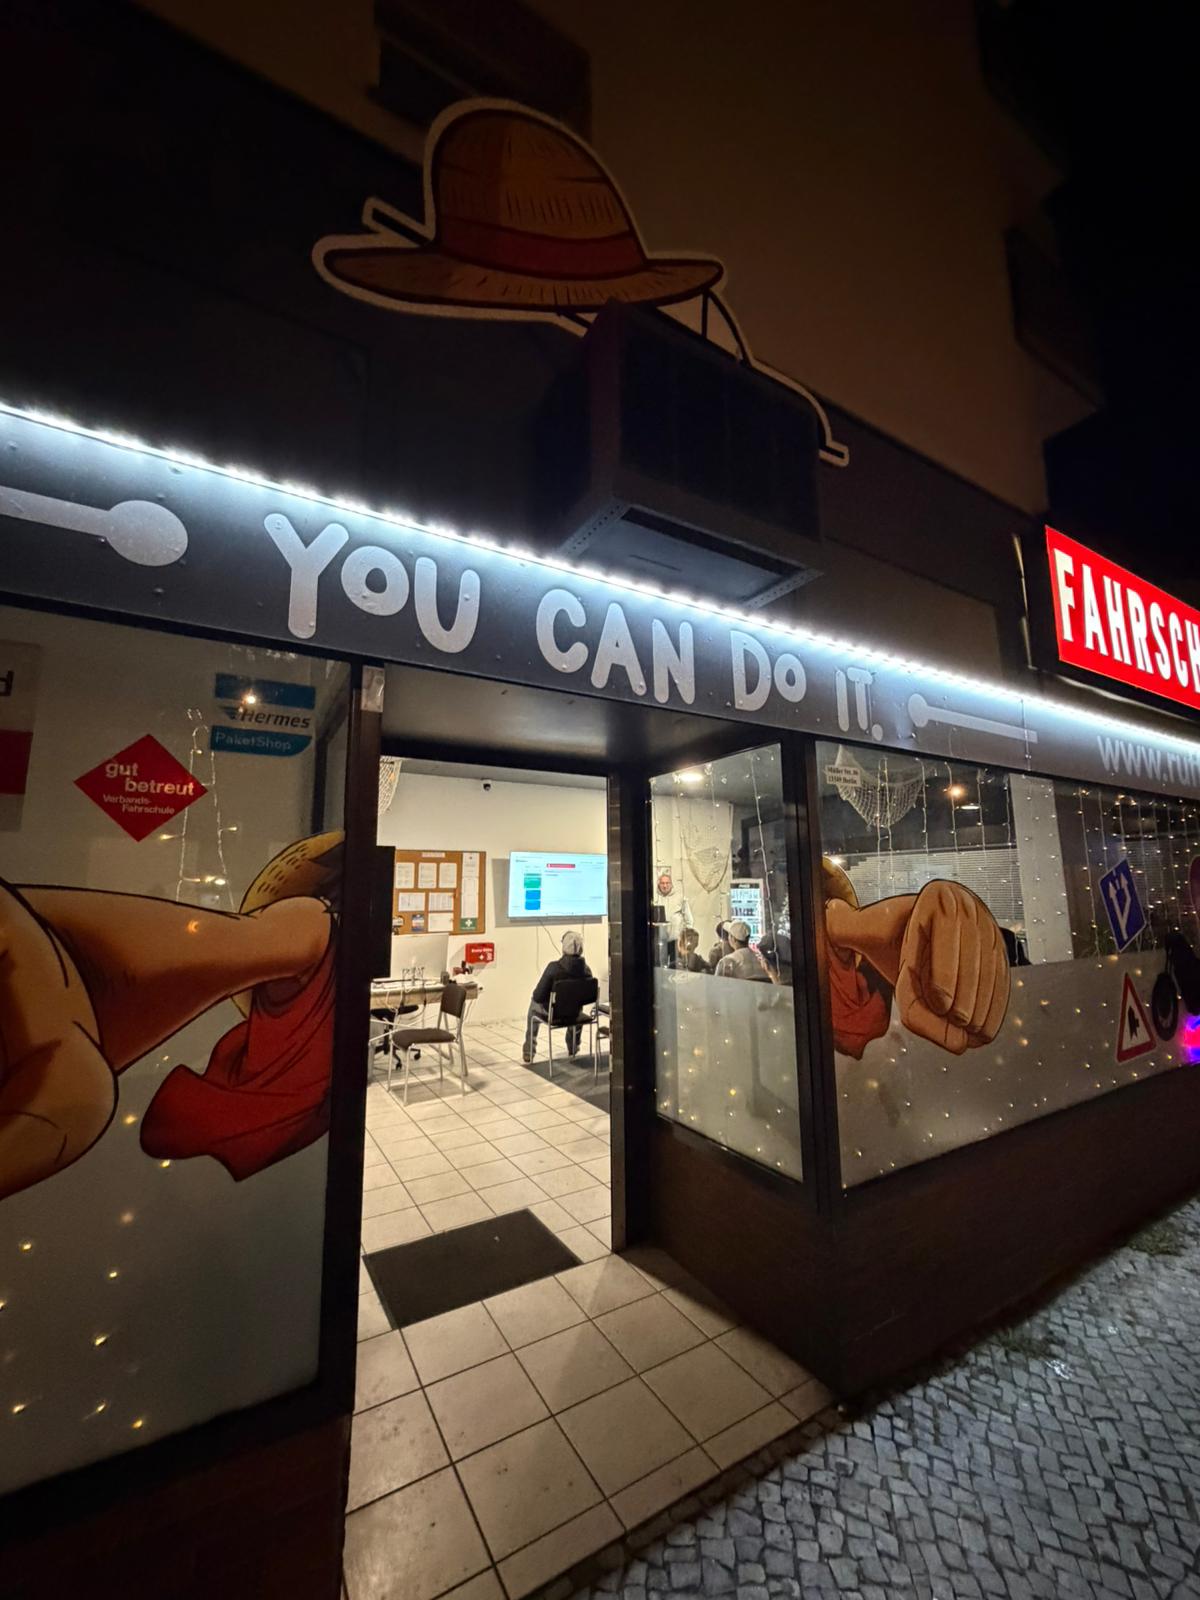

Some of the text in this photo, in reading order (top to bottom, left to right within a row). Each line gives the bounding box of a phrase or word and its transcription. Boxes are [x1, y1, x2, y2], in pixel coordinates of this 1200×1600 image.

[1053, 547, 1200, 695] FAHRSCH
[536, 588, 696, 705] CAN
[834, 666, 884, 742] IT.
[240, 708, 311, 729] Hermes
[215, 731, 292, 752] PaketShop
[105, 762, 139, 779] gut
[125, 778, 195, 796] betreut
[102, 793, 152, 806] Verbands-
[122, 804, 176, 815] Fahrschule
